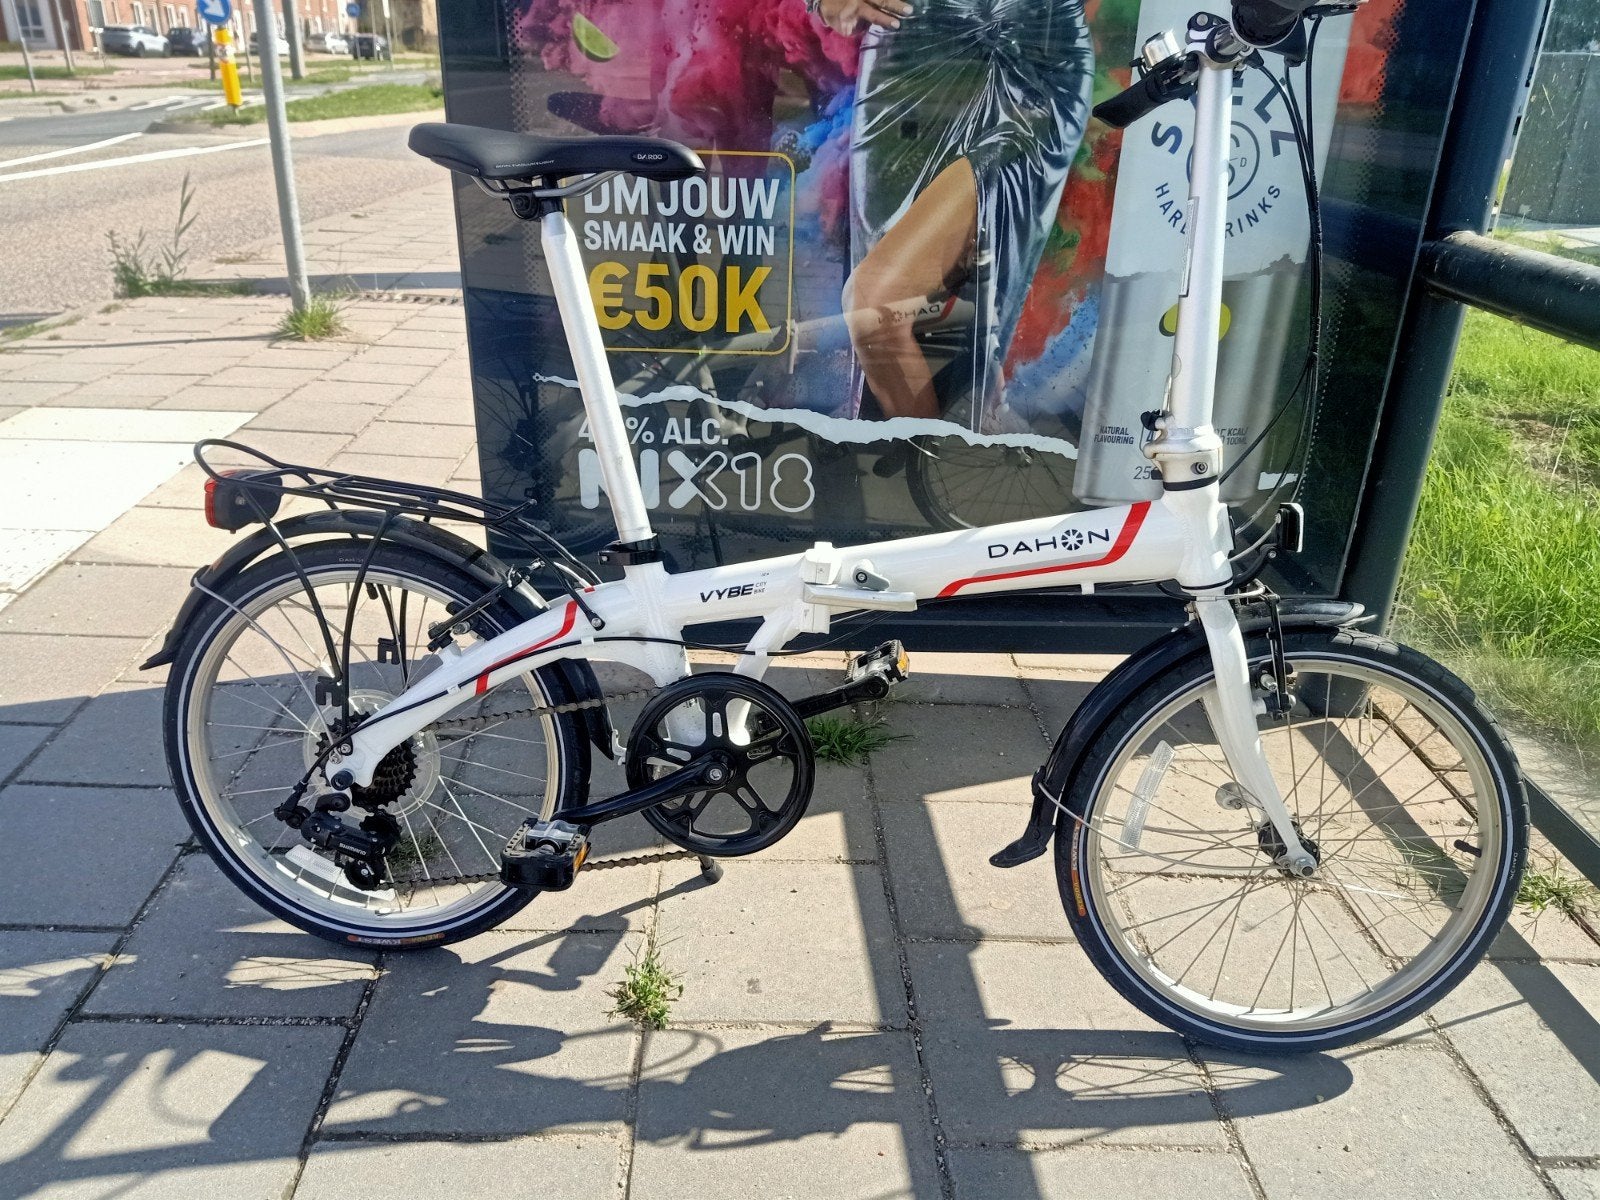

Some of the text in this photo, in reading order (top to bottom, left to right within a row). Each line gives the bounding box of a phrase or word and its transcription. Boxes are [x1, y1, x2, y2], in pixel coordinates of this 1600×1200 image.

[1151, 75, 1302, 157] SLZ
[584, 173, 780, 220] DM JOUW
[1224, 184, 1281, 239] RINKS
[583, 220, 775, 256] SMAAK & WIN
[589, 261, 773, 333] €50K
[662, 416, 729, 446] ALC.
[1094, 434, 1135, 445] FLAVOURING
[1099, 425, 1129, 436] NATURAL
[1133, 466, 1158, 480] 25
[987, 528, 1110, 559] DAHON
[700, 583, 755, 603] VYBE
